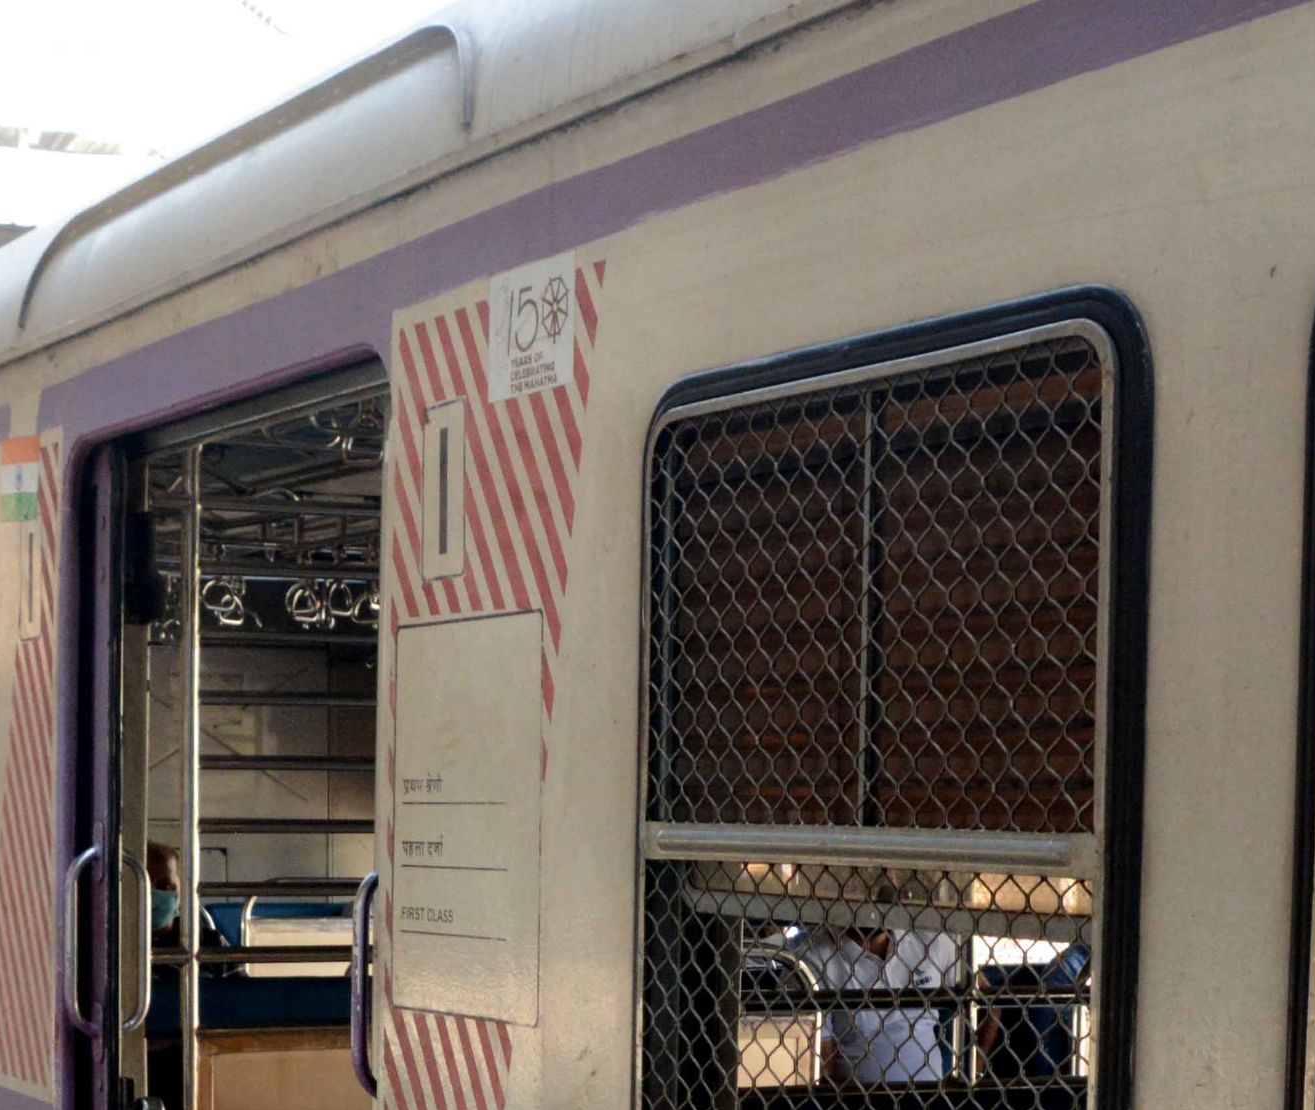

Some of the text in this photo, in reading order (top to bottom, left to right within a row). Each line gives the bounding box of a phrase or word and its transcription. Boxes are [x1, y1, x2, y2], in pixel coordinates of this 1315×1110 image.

[510, 361, 556, 381] CELEBRATING
[401, 905, 454, 923] FIRST CLASS
